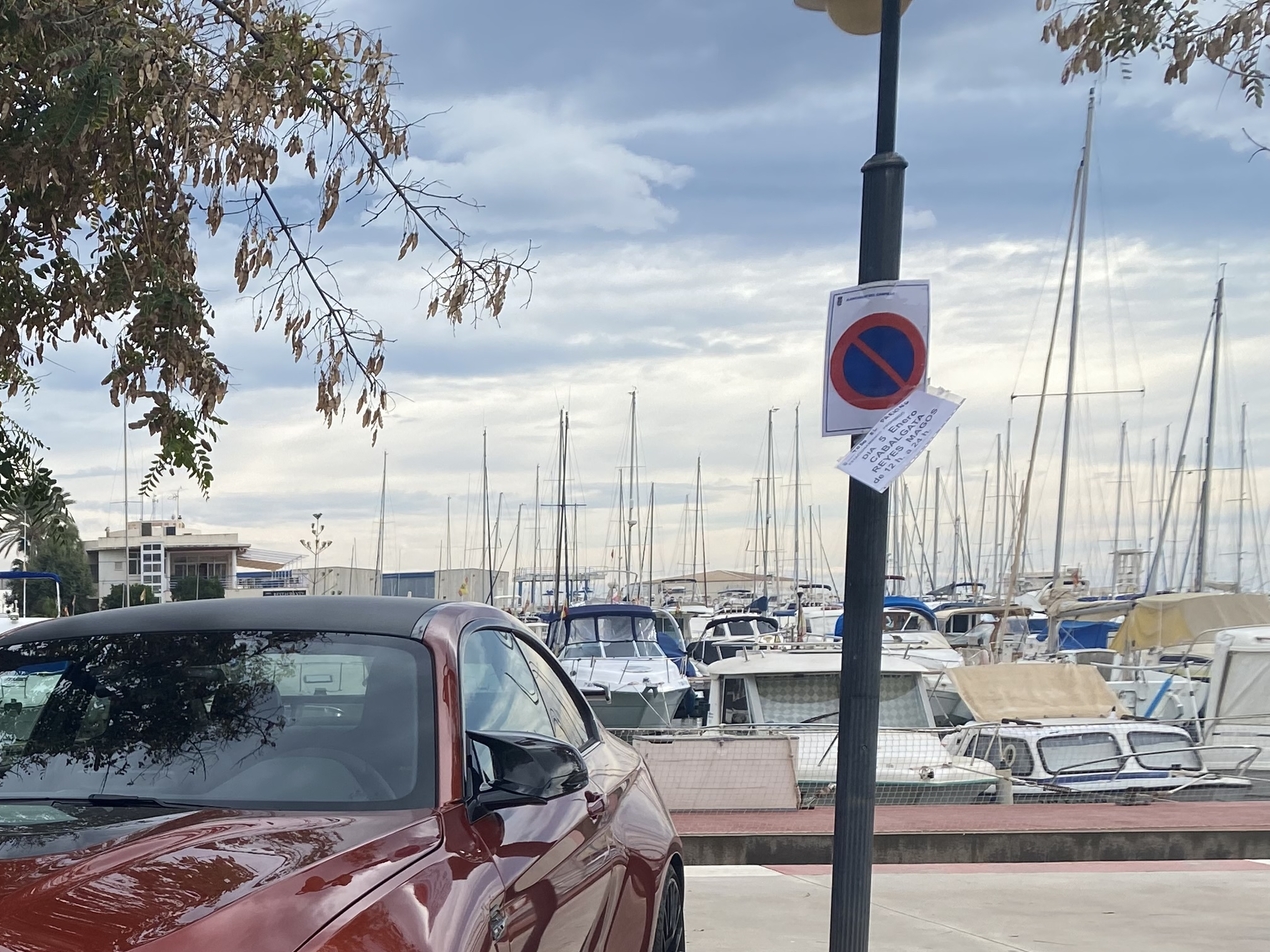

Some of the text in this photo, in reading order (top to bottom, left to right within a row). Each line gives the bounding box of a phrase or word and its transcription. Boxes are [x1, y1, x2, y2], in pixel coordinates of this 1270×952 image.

[862, 410, 918, 460] DIA 5 Enero
[869, 413, 925, 464] CABALGATA
[871, 407, 938, 473] REYES MAGOS
[873, 474, 885, 484] de
[884, 461, 895, 473] 12
[911, 438, 922, 448] 24
